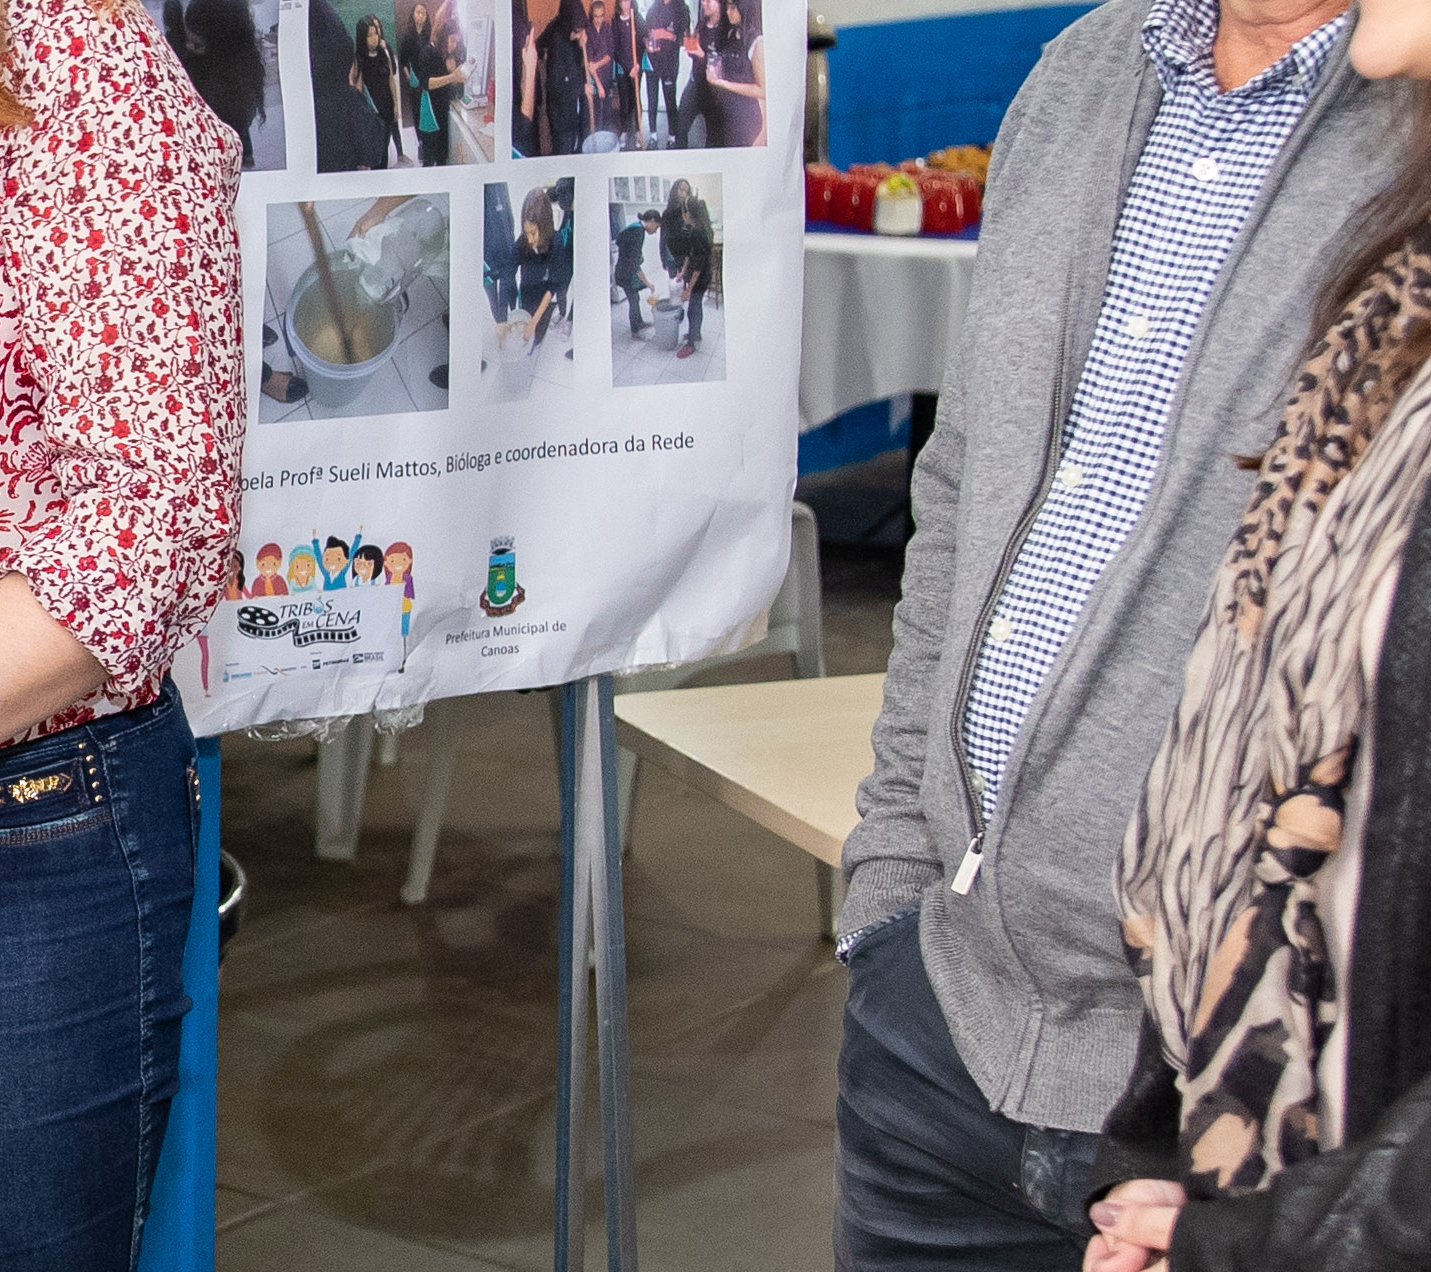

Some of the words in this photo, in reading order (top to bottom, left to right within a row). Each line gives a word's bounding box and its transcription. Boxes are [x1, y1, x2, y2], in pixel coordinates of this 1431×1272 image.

[328, 462, 371, 484] Sueli
[375, 460, 442, 479] Mattos,
[445, 452, 491, 474] Bióloga
[494, 451, 503, 465] e
[505, 437, 619, 463] coordenadora
[624, 434, 646, 453] da
[651, 431, 695, 451] Rede
[315, 609, 361, 628] CENA
[445, 628, 490, 645] Prefeitura
[493, 621, 549, 637] Municipal
[551, 620, 567, 632] de
[481, 644, 520, 657] Canoas
